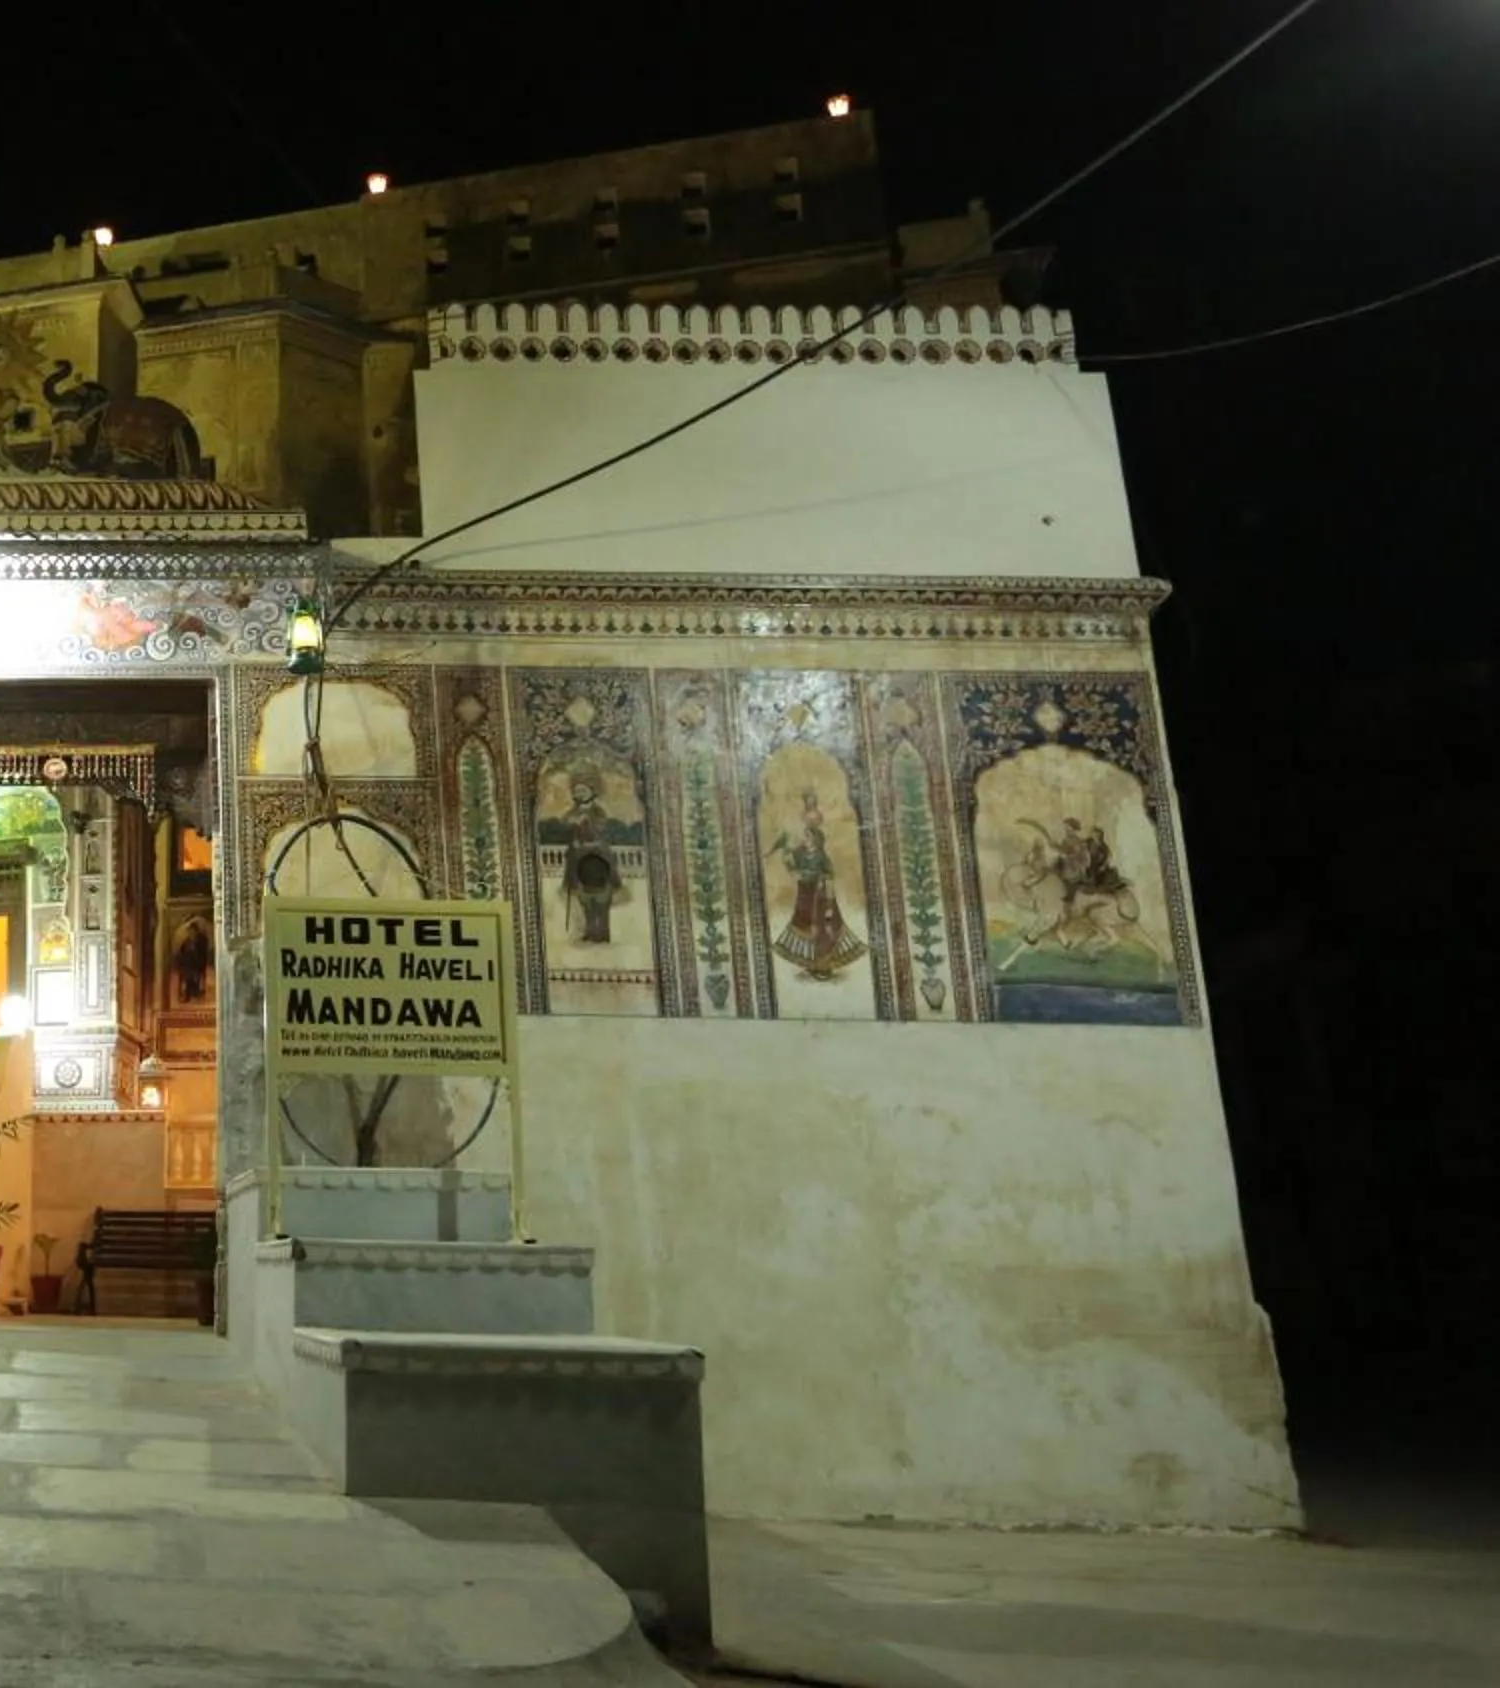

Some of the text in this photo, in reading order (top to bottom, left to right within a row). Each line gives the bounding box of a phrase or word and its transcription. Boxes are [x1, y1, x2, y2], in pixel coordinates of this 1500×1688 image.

[305, 916, 479, 947] HOTEL
[280, 948, 494, 982] RADHIKA HAVELI
[286, 988, 482, 1028] MANDAWA
